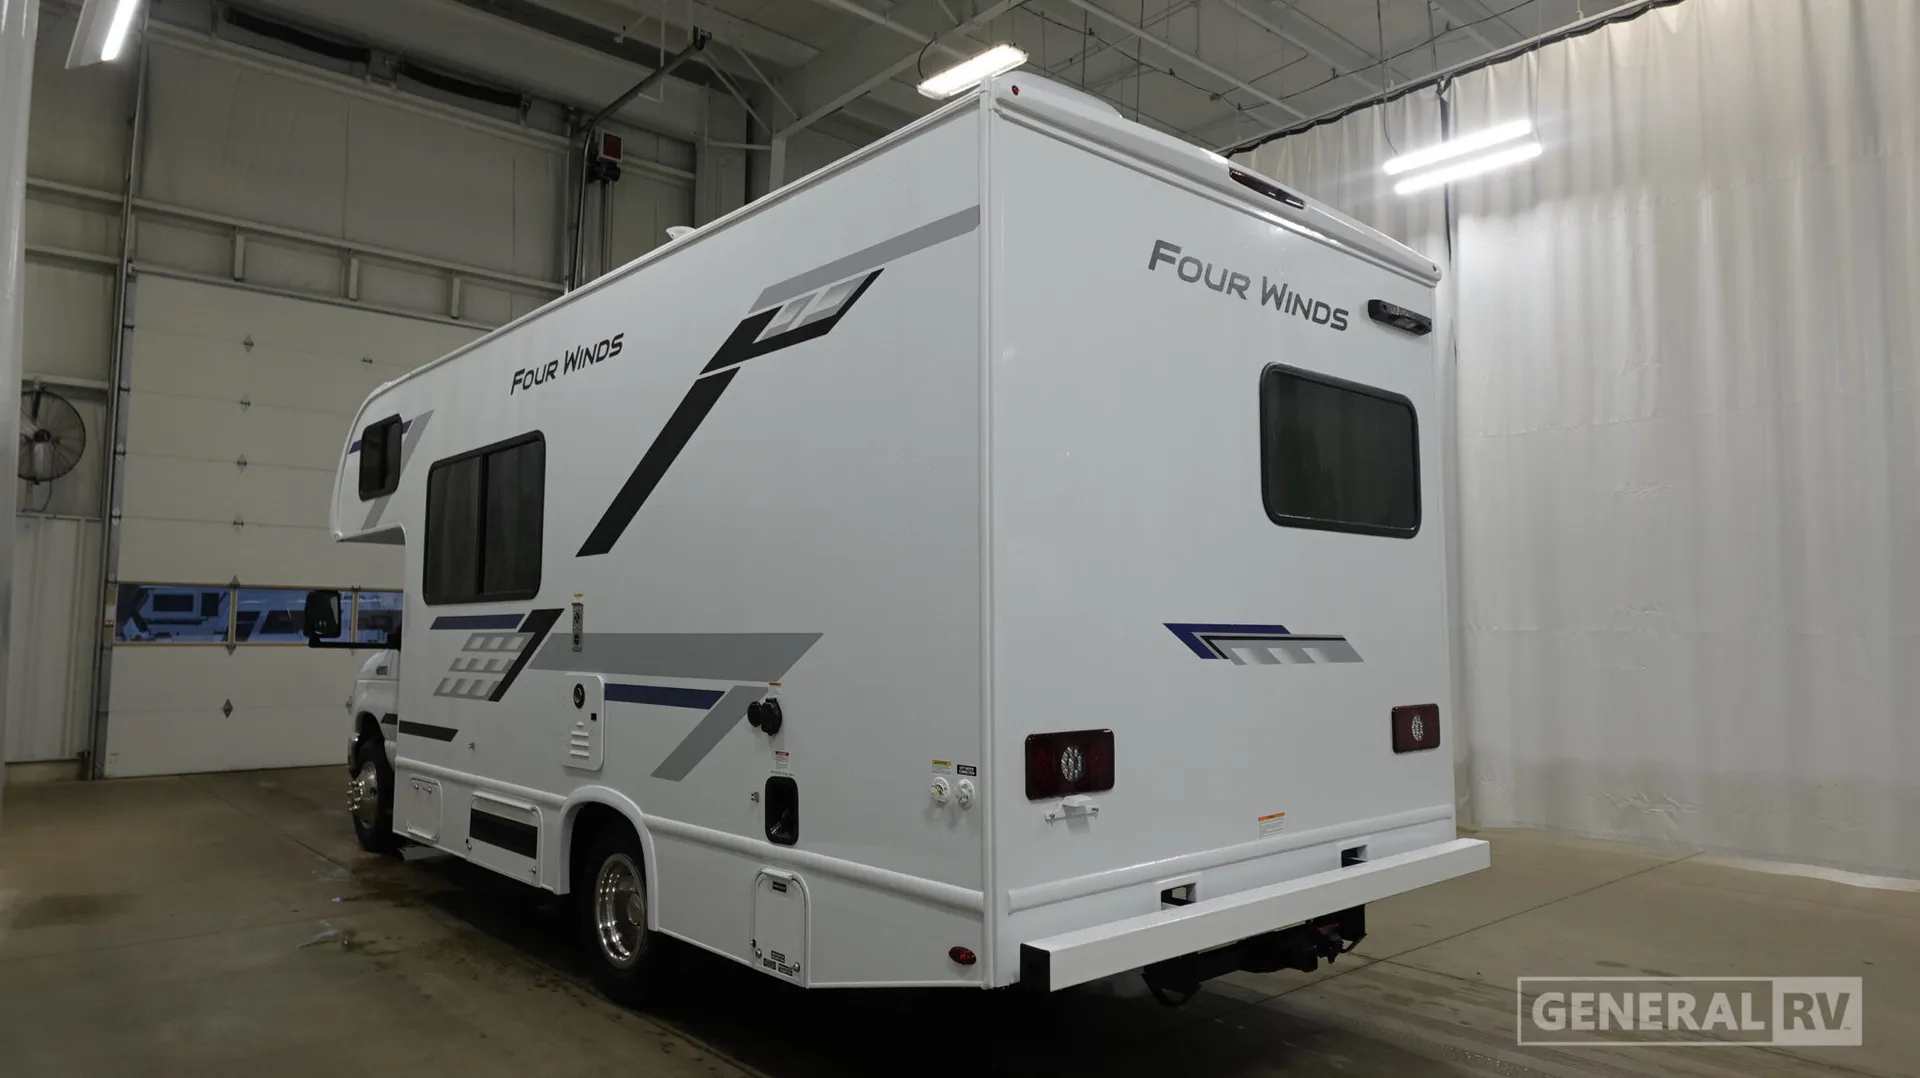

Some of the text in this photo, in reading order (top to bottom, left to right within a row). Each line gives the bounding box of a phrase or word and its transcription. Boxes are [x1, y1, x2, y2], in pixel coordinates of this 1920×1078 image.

[1148, 239, 1349, 332] FOUR WINDS
[510, 332, 625, 396] FOUR WINDS
